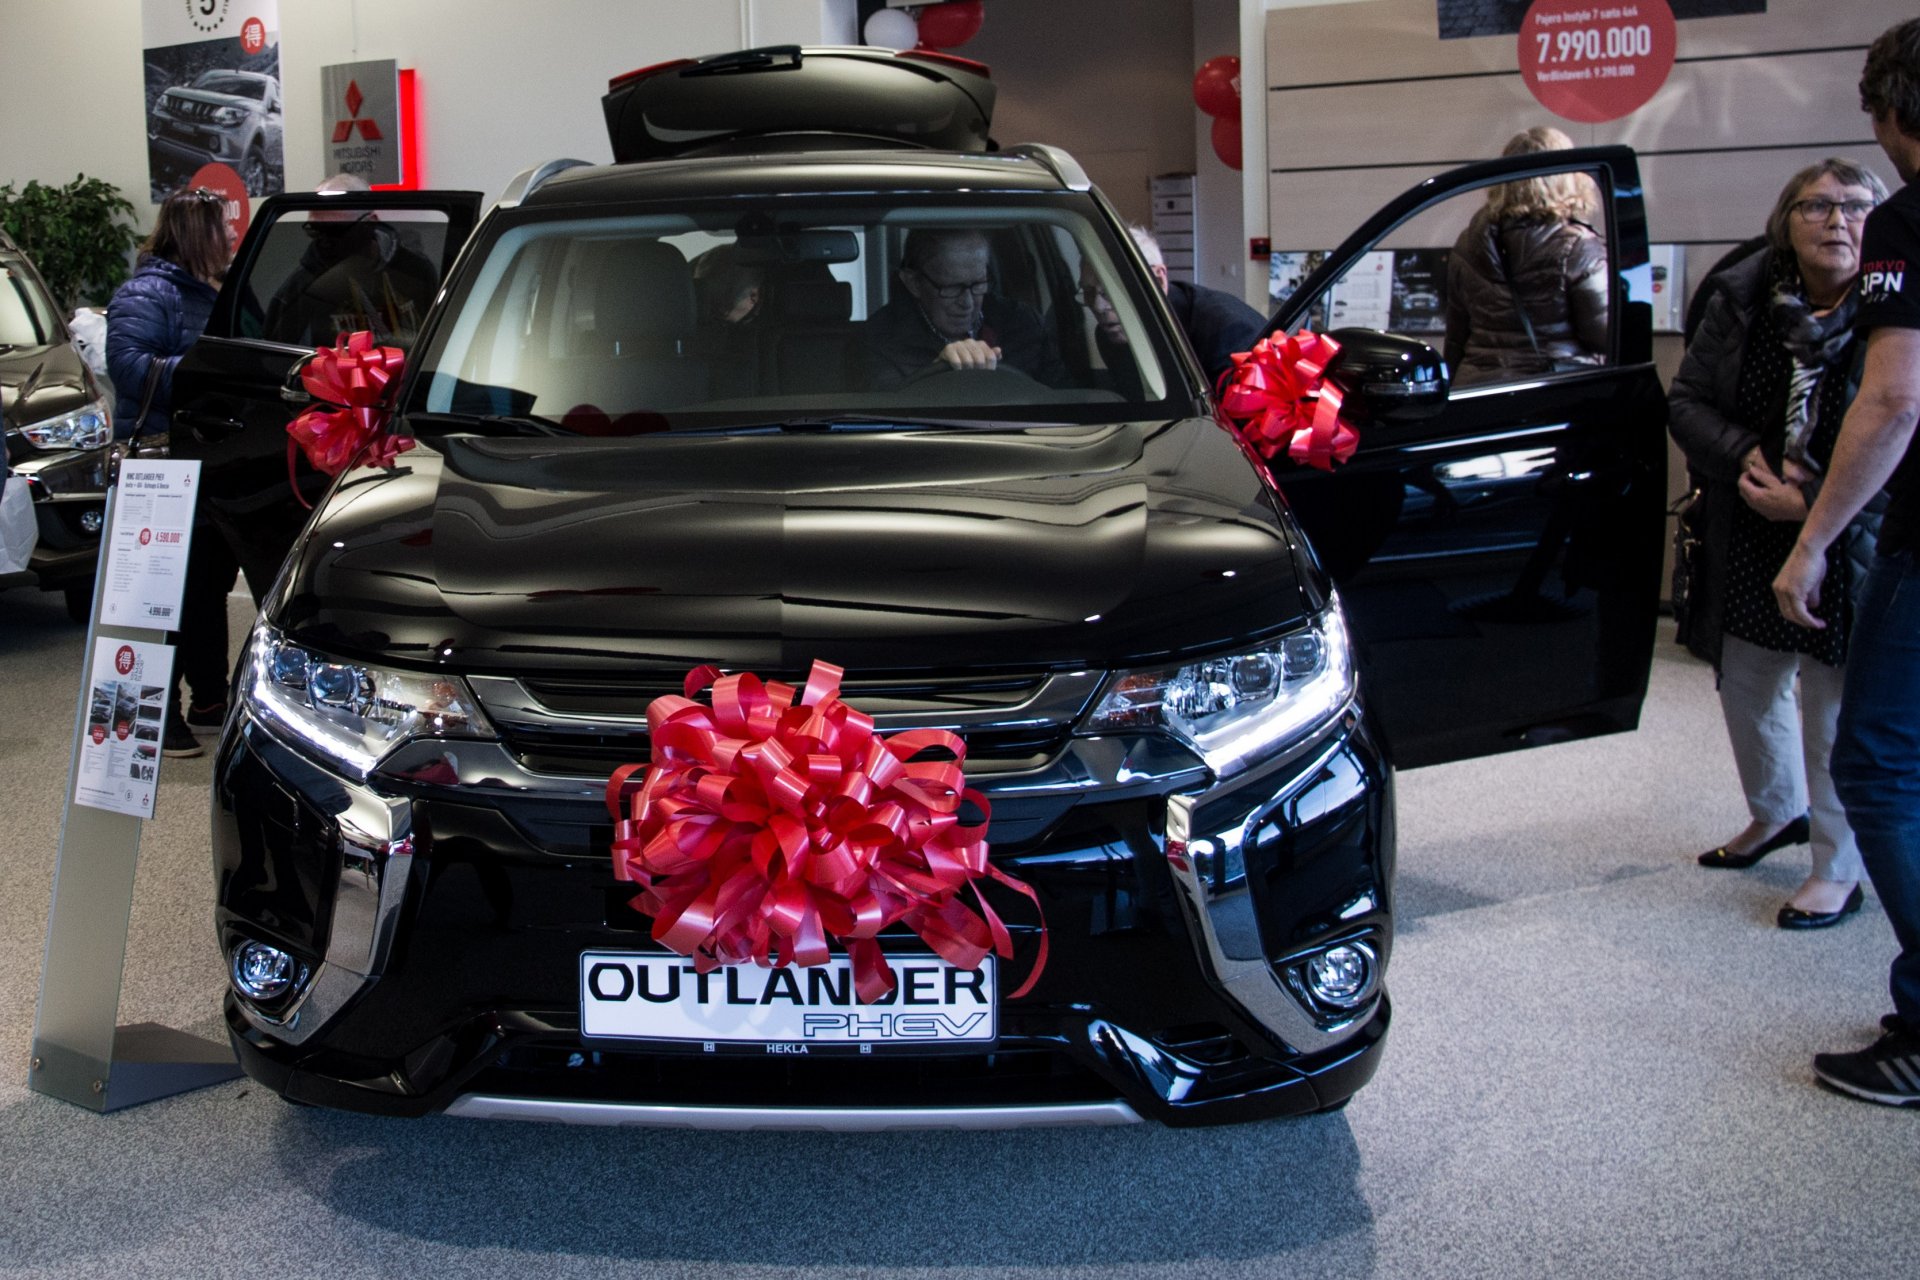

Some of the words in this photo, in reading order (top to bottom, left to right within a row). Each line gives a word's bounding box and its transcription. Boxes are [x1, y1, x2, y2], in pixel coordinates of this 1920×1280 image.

[1535, 12, 1561, 26] Pajero
[1592, 8, 1599, 20] 7
[1536, 24, 1651, 64] 7.990.000
[333, 145, 381, 160] MITSUBISHI
[339, 160, 374, 174] MOTORS
[1863, 260, 1906, 273] TOKYO
[1861, 272, 1903, 296] JPN
[803, 1012, 988, 1037] PHEV
[766, 1043, 808, 1054] HEKLA
